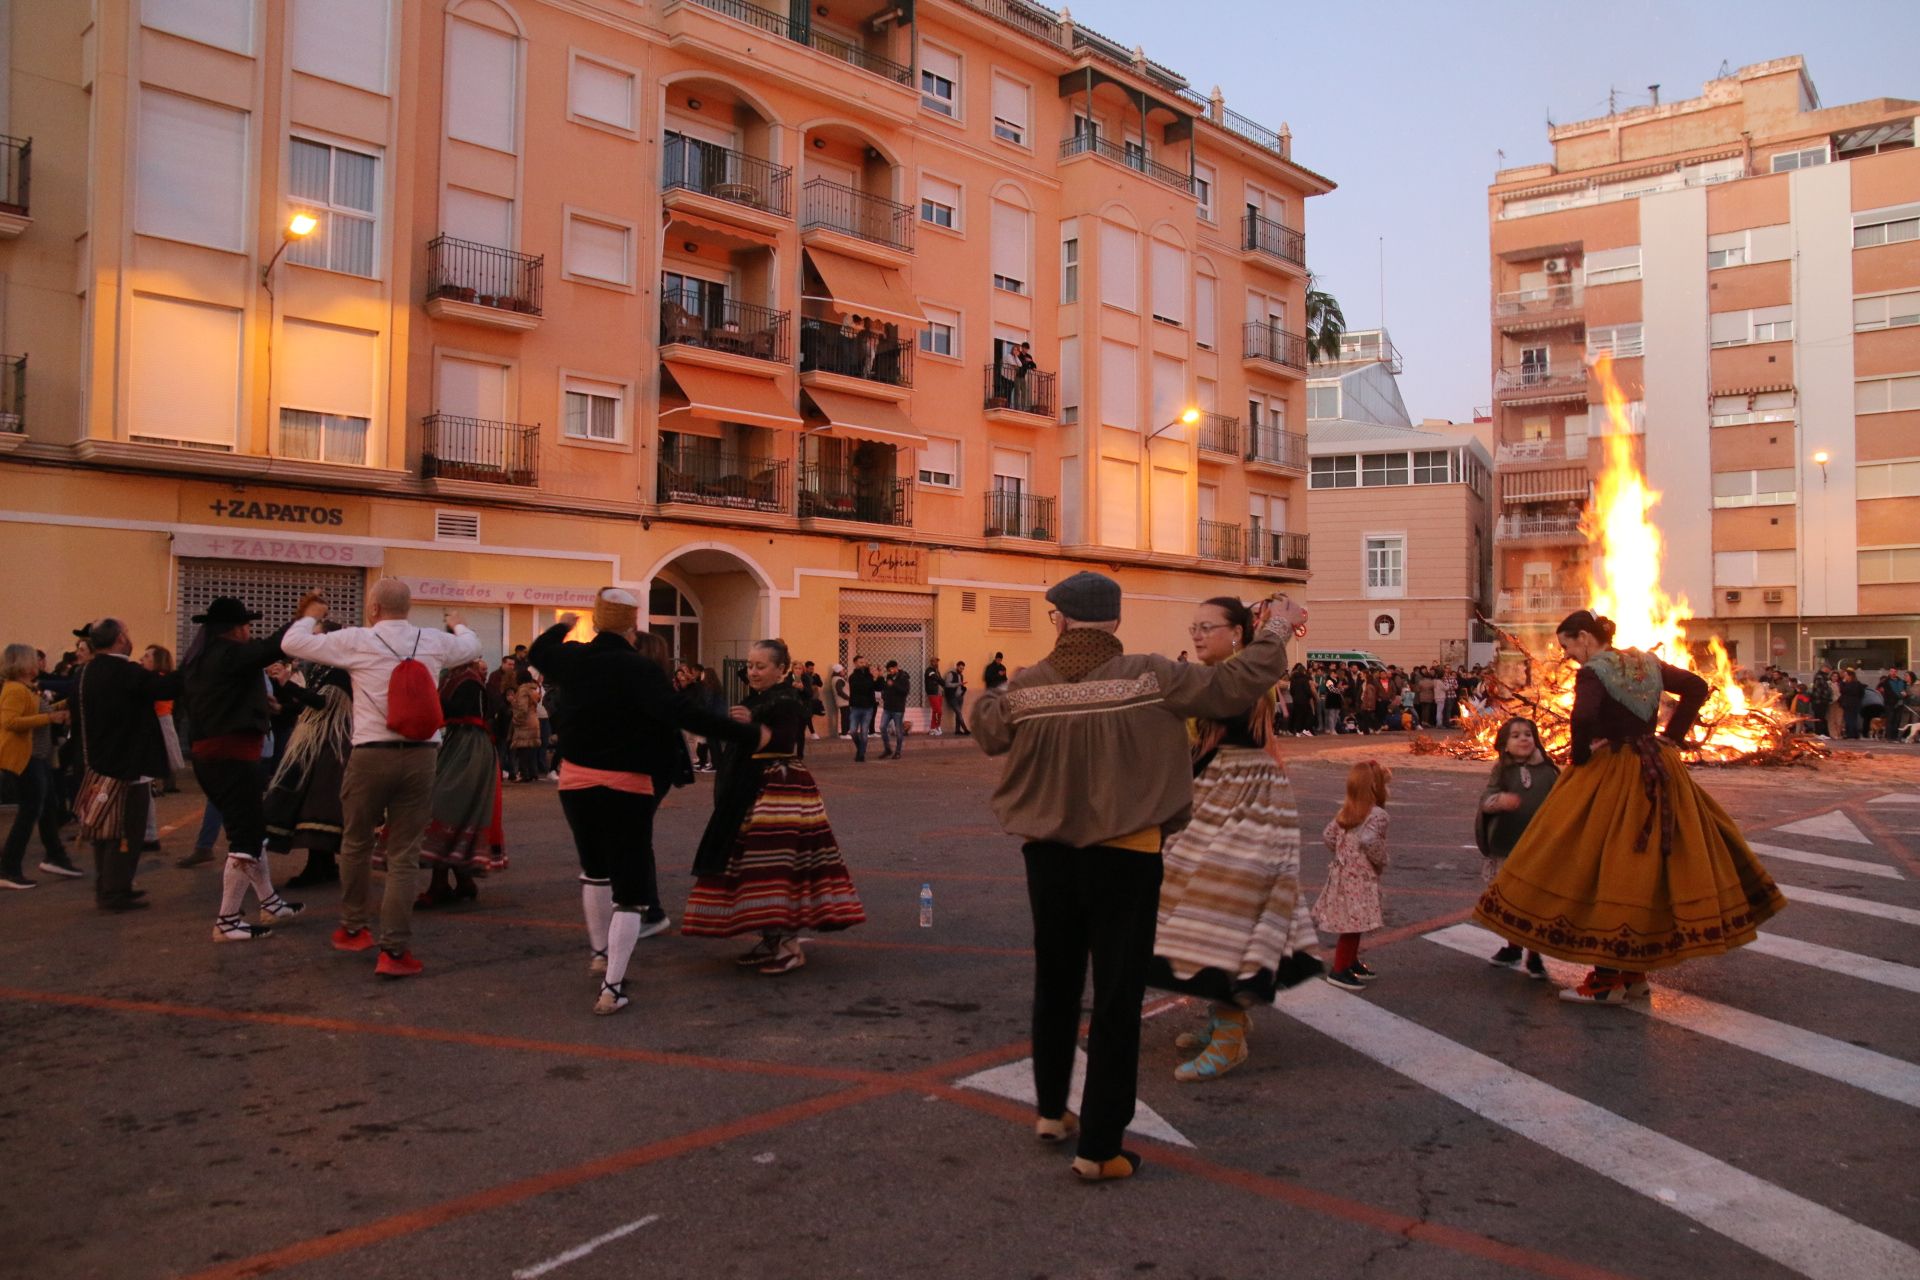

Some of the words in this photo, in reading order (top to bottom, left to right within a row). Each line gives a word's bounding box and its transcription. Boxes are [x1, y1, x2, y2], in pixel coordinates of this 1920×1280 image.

[209, 499, 343, 525] +ZAPATOS
[231, 540, 354, 562] ZAPATOS
[419, 581, 491, 598] Calzados
[505, 590, 515, 601] y
